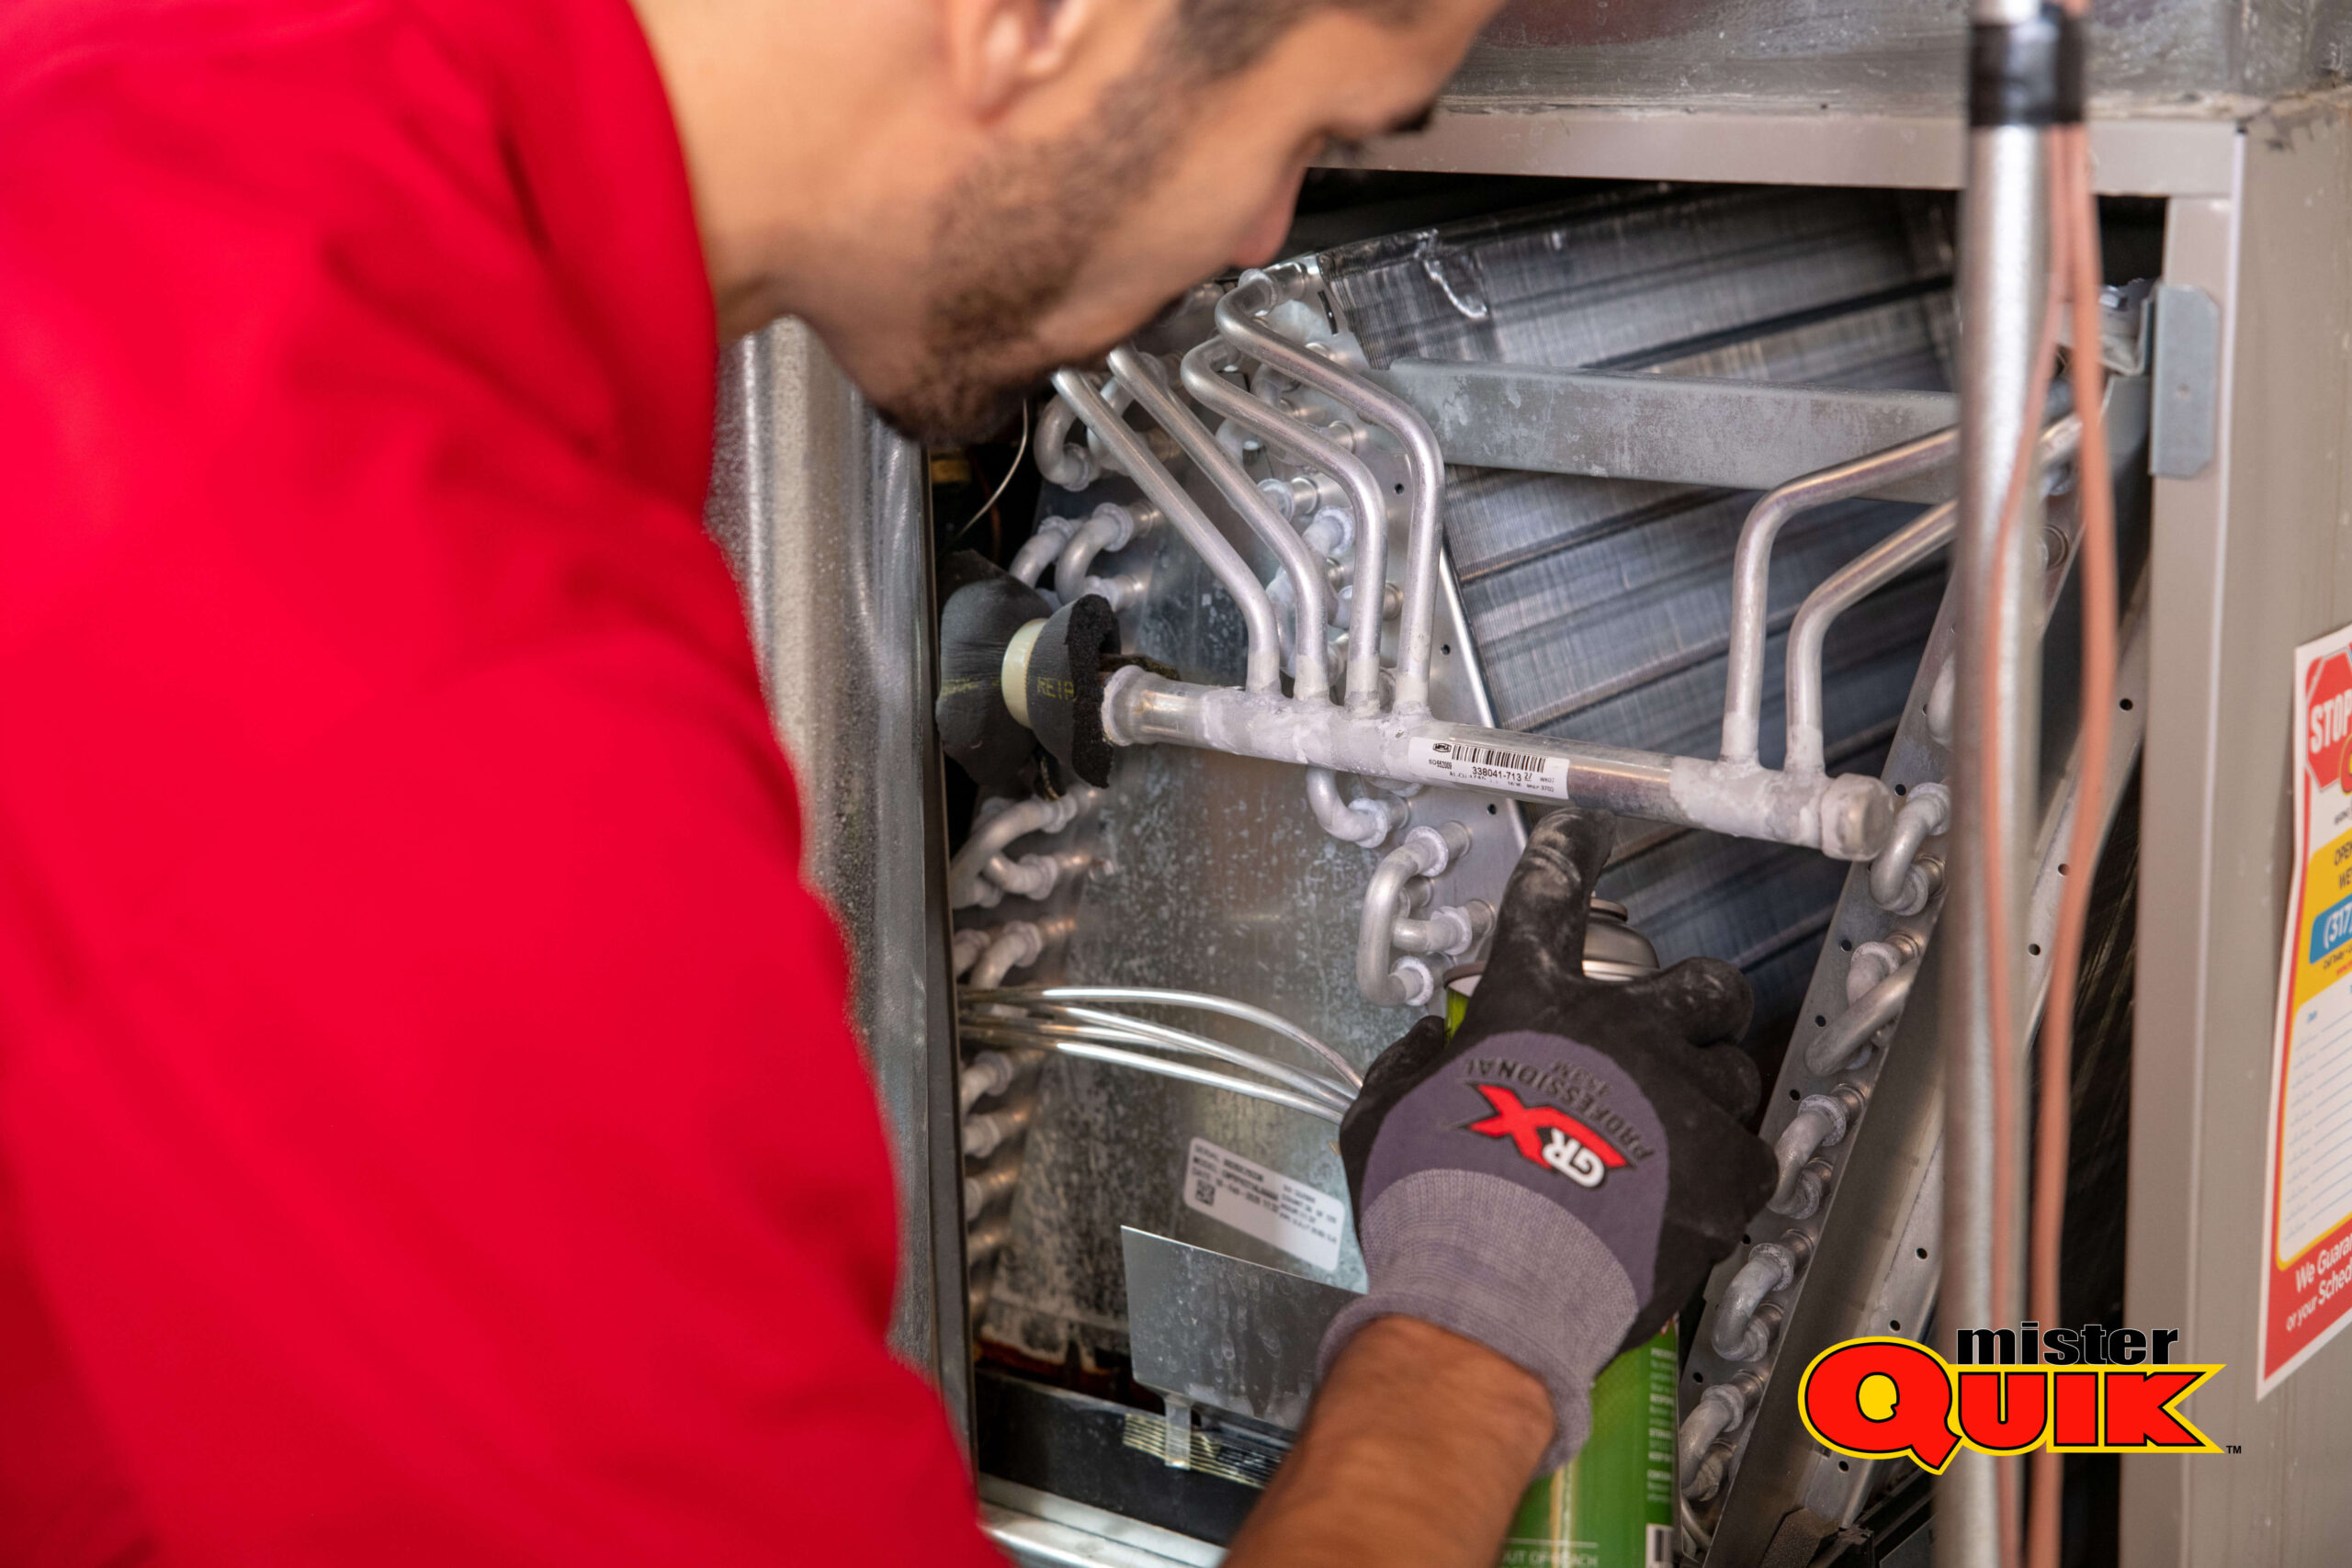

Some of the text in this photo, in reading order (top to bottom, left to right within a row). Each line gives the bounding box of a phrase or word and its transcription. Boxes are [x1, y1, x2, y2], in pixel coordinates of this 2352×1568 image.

[2311, 689, 2352, 753] STOP
[1472, 766, 1522, 782] 338041-713
[2334, 840, 2352, 866] OPE
[1464, 1057, 1654, 1160] PROFESSIONAL
[1464, 1083, 1630, 1188] GRX
[2295, 1262, 2315, 1293] We
[2286, 1313, 2297, 1332] or
[2297, 1295, 2318, 1327] your
